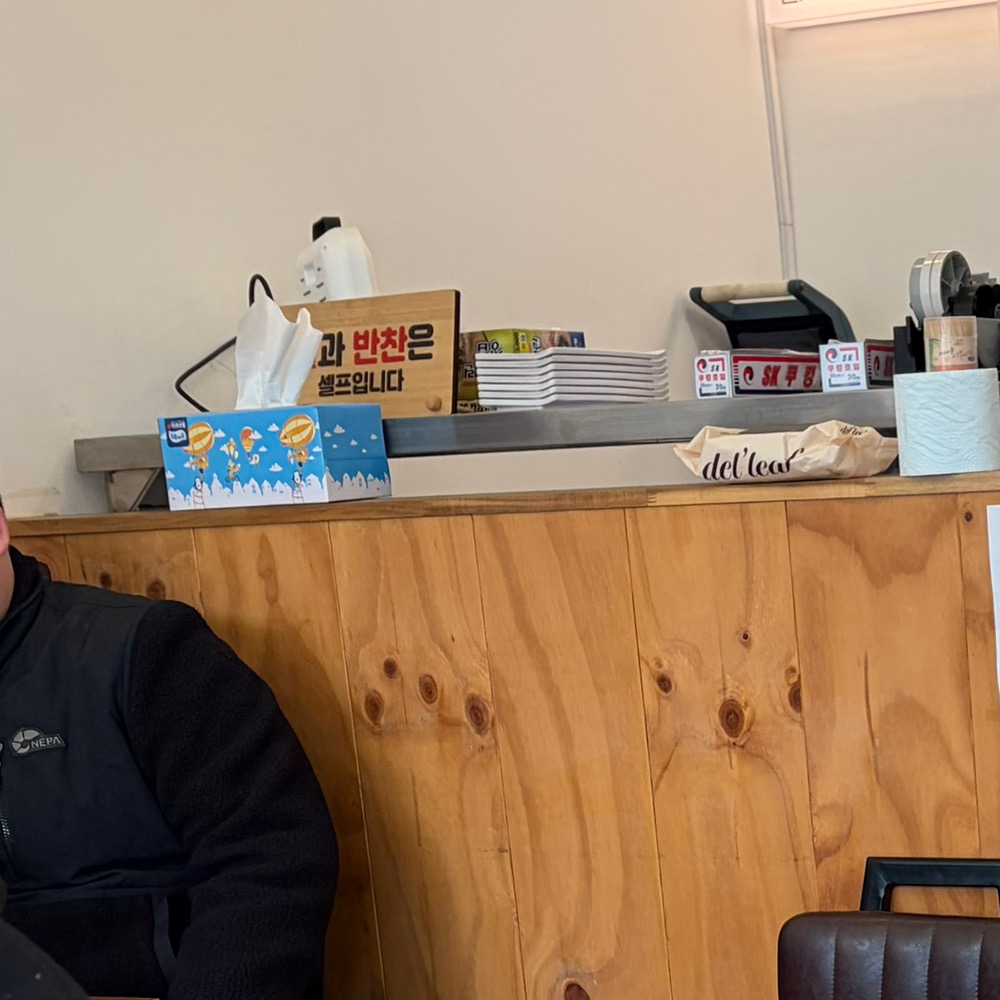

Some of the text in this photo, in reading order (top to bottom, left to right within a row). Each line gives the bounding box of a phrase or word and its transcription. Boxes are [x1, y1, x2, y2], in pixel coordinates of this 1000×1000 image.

[311, 323, 434, 369] 과 반찬은
[318, 368, 404, 397] 셀프입니다
[761, 365, 781, 387] SK
[31, 736, 61, 748] NEPA
